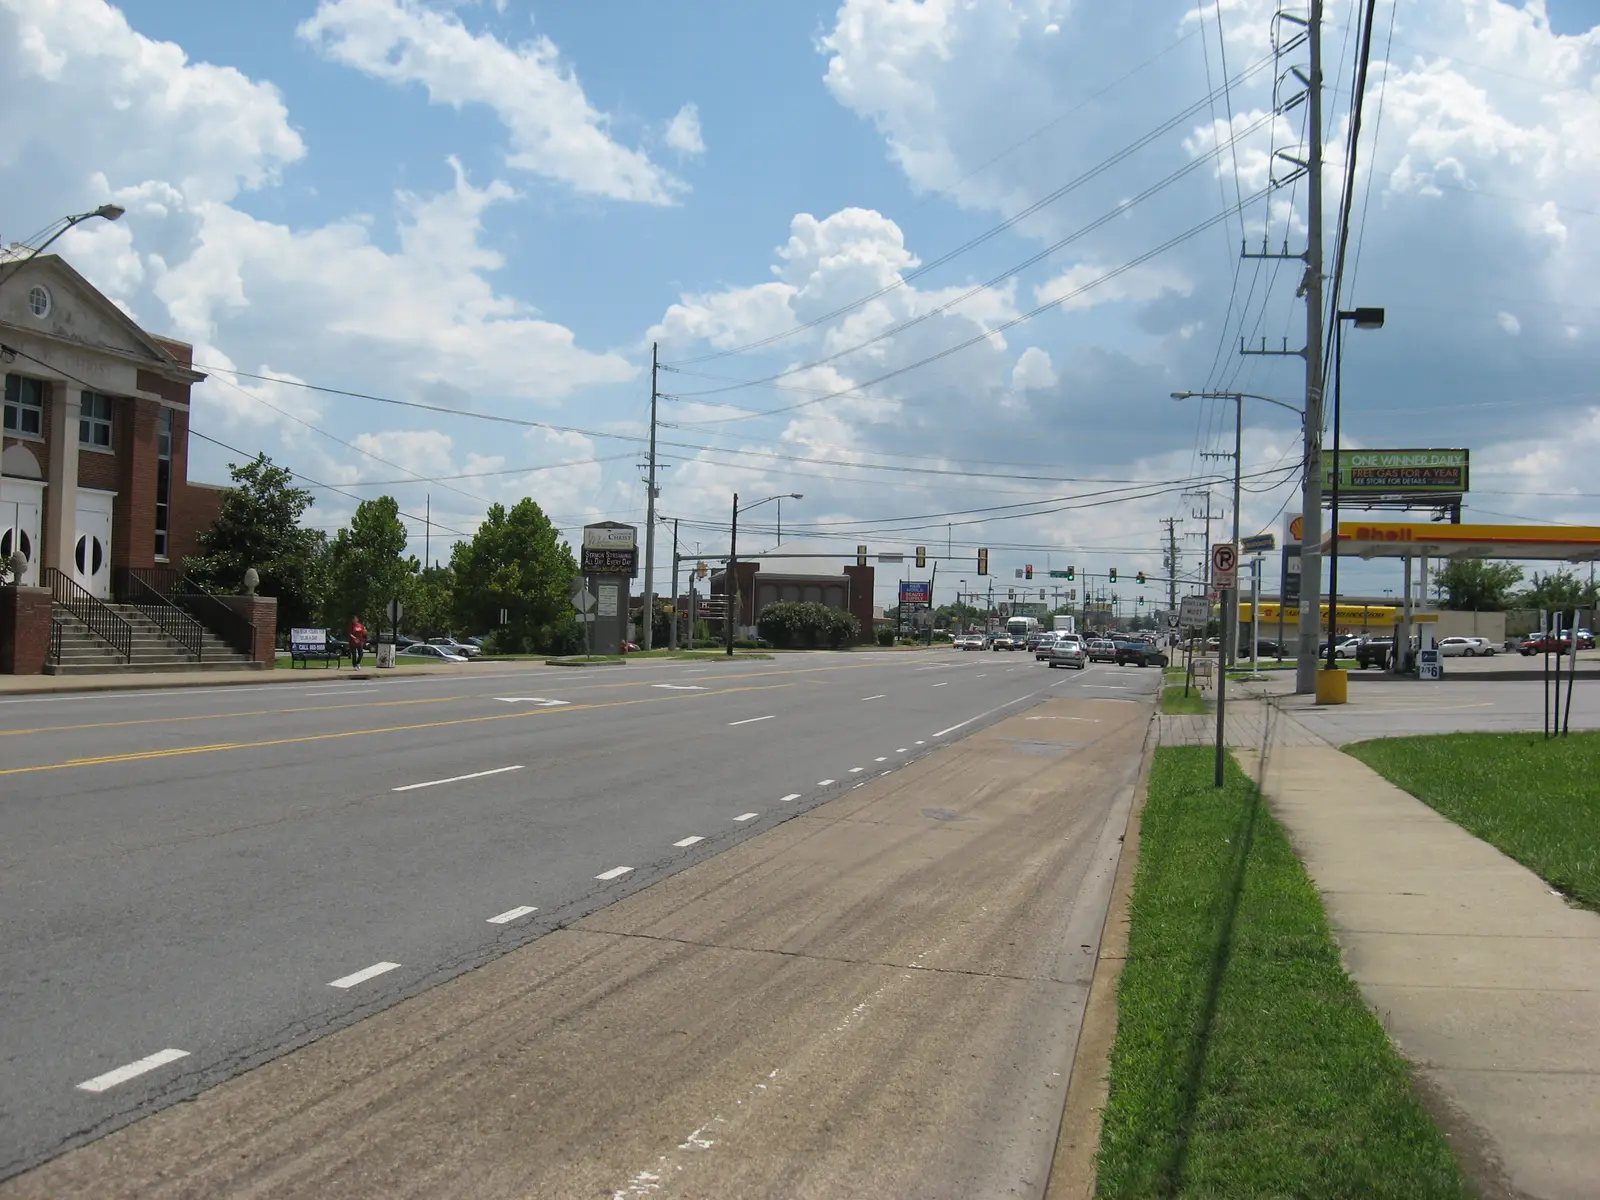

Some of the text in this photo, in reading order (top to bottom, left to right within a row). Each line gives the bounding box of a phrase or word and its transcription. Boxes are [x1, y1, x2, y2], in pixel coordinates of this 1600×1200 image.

[1352, 455, 1462, 467] ONE WINNER DAILY
[1352, 469, 1459, 478] FREE GAS FOR A YEAR
[1402, 477, 1427, 485] DETAILS
[608, 533, 632, 541] CHRIST
[1356, 526, 1412, 541] Shell
